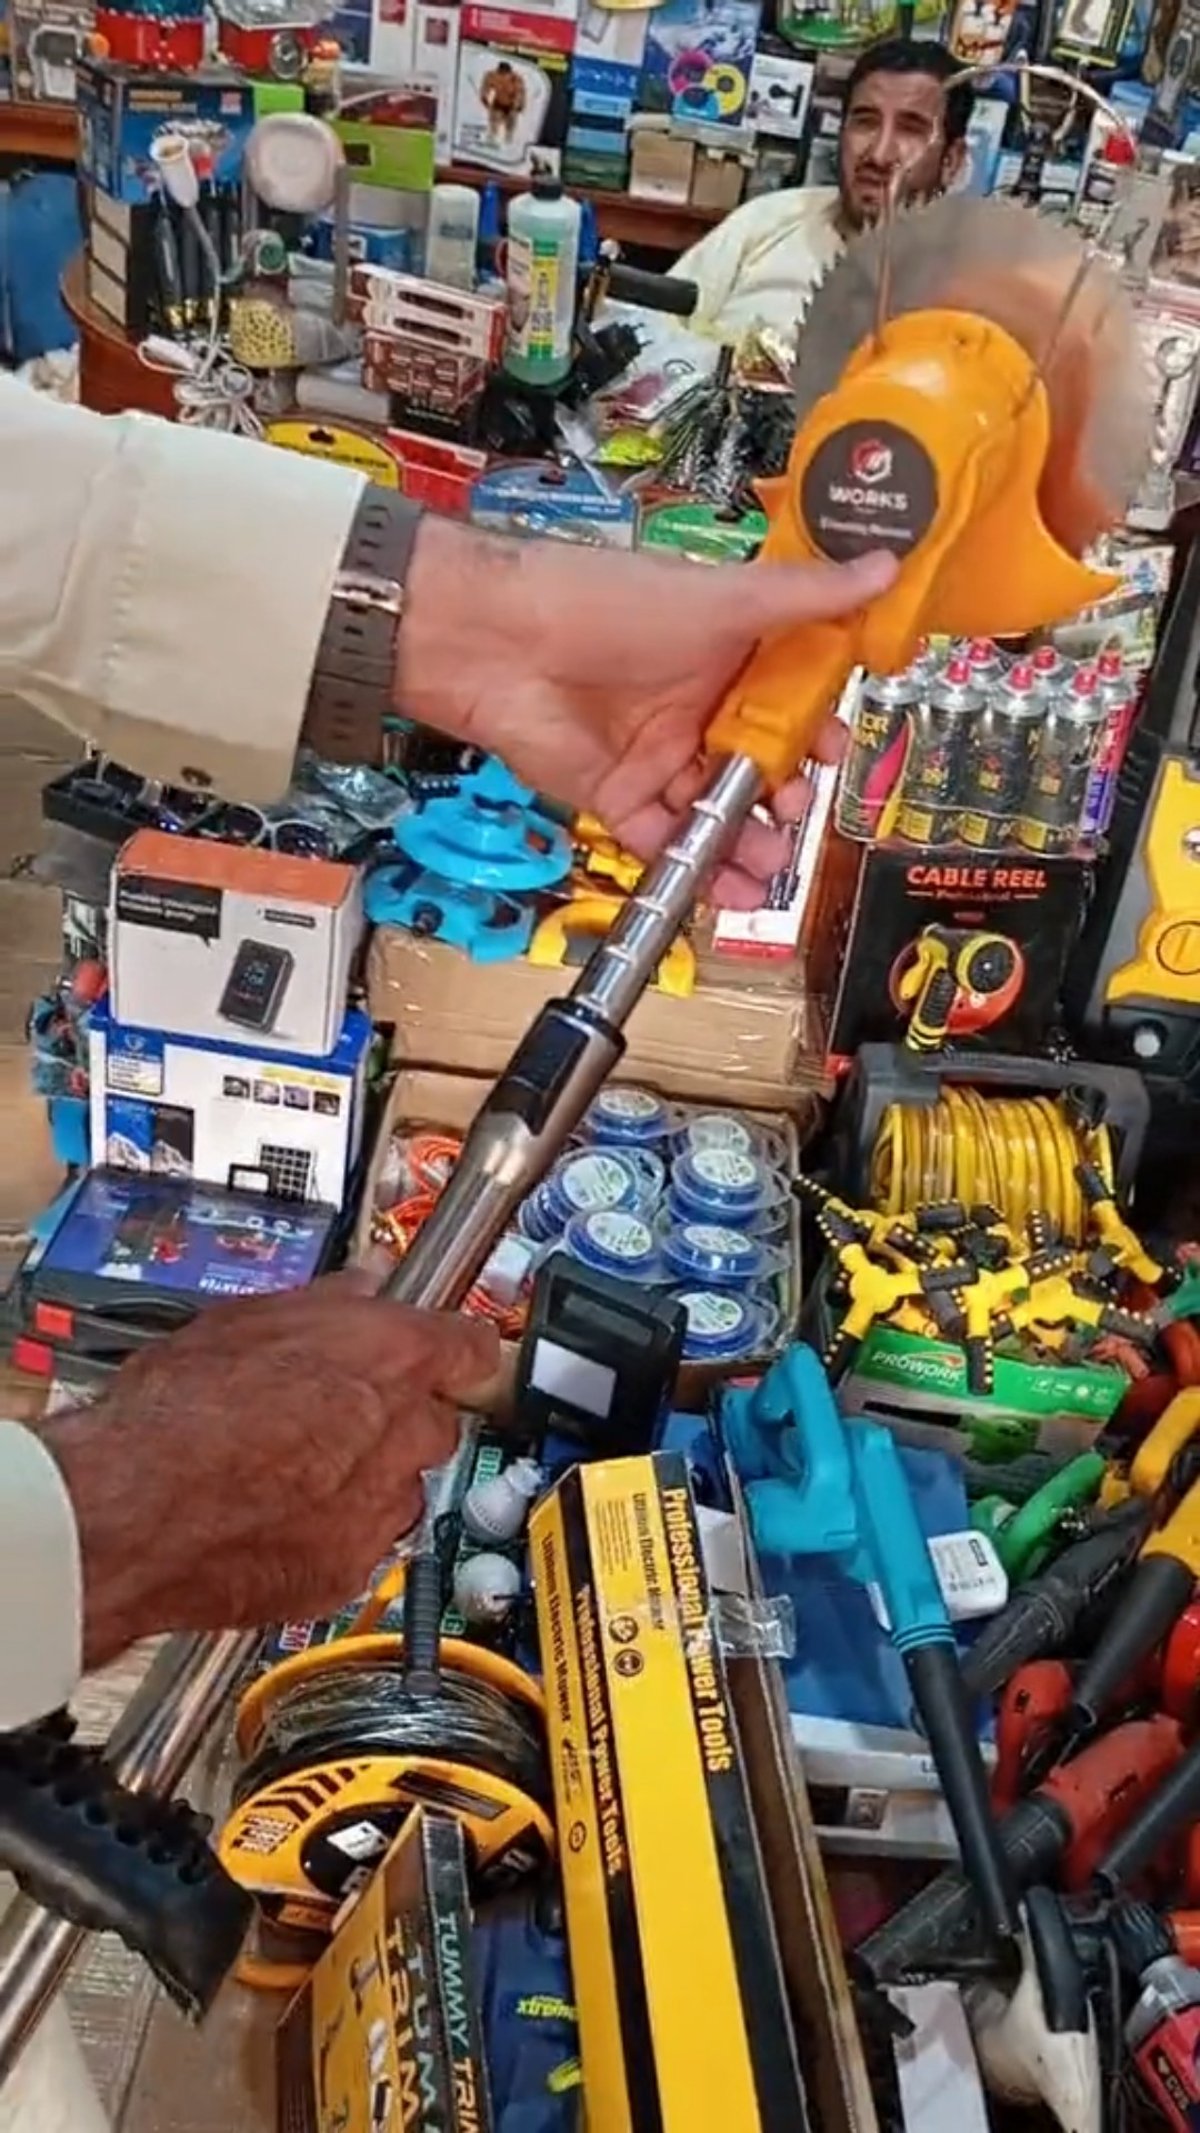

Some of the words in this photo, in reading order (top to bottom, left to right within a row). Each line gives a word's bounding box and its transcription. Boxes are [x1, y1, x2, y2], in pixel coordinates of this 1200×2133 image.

[828, 482, 909, 511] WORKS
[907, 865, 987, 888] CABLE
[992, 869, 1047, 888] REEL
[872, 1351, 960, 1381] PROWORK
[661, 1487, 707, 1624] Professional
[576, 1584, 606, 1728] Professional
[685, 1627, 718, 1700] Power
[592, 1724, 612, 1802] Power
[698, 1701, 734, 1772] Tools
[601, 1799, 622, 1876] Tools
[439, 1911, 470, 2049] TUMMY
[386, 1917, 419, 2124] TRIM
